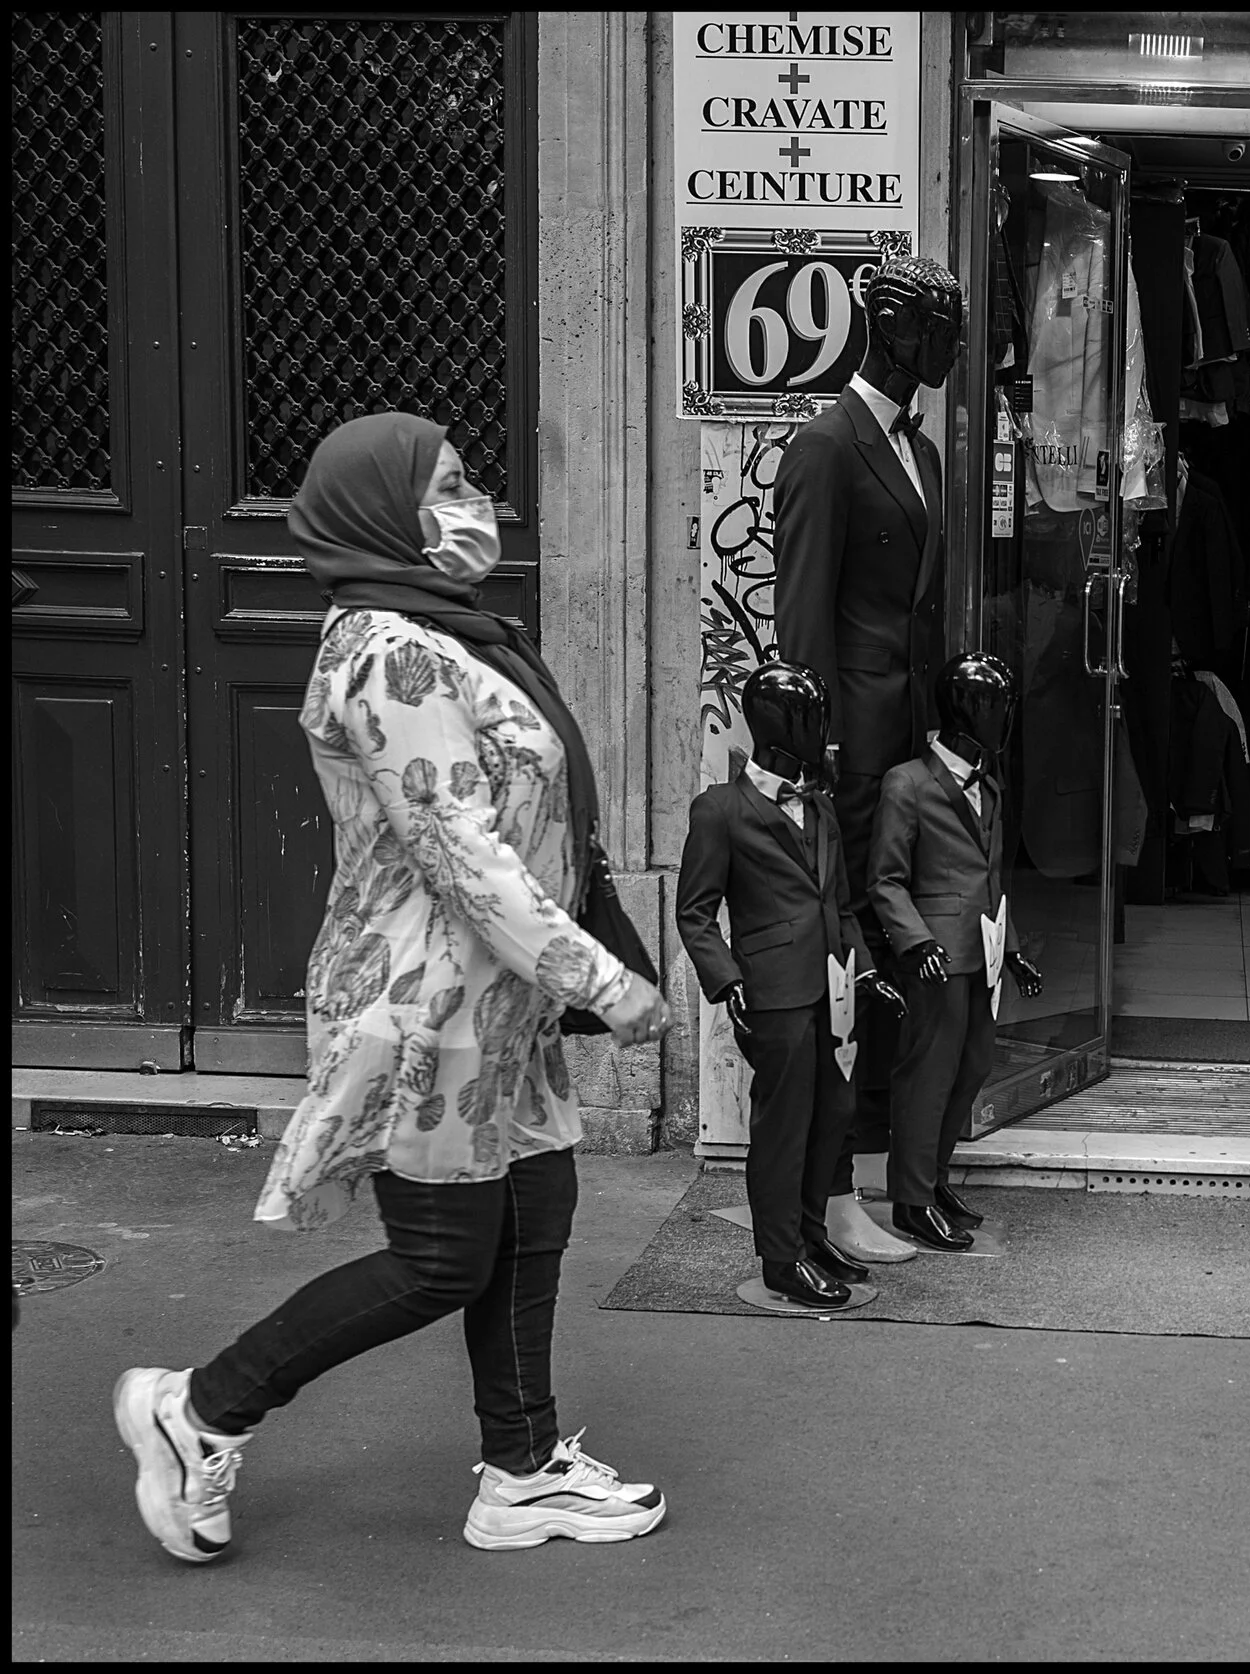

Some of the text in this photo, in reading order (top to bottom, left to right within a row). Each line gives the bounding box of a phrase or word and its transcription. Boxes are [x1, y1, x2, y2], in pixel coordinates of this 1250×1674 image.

[696, 22, 893, 57] CHEMISE
[701, 97, 887, 131] CRAVATE
[687, 170, 903, 204] CEINTURE
